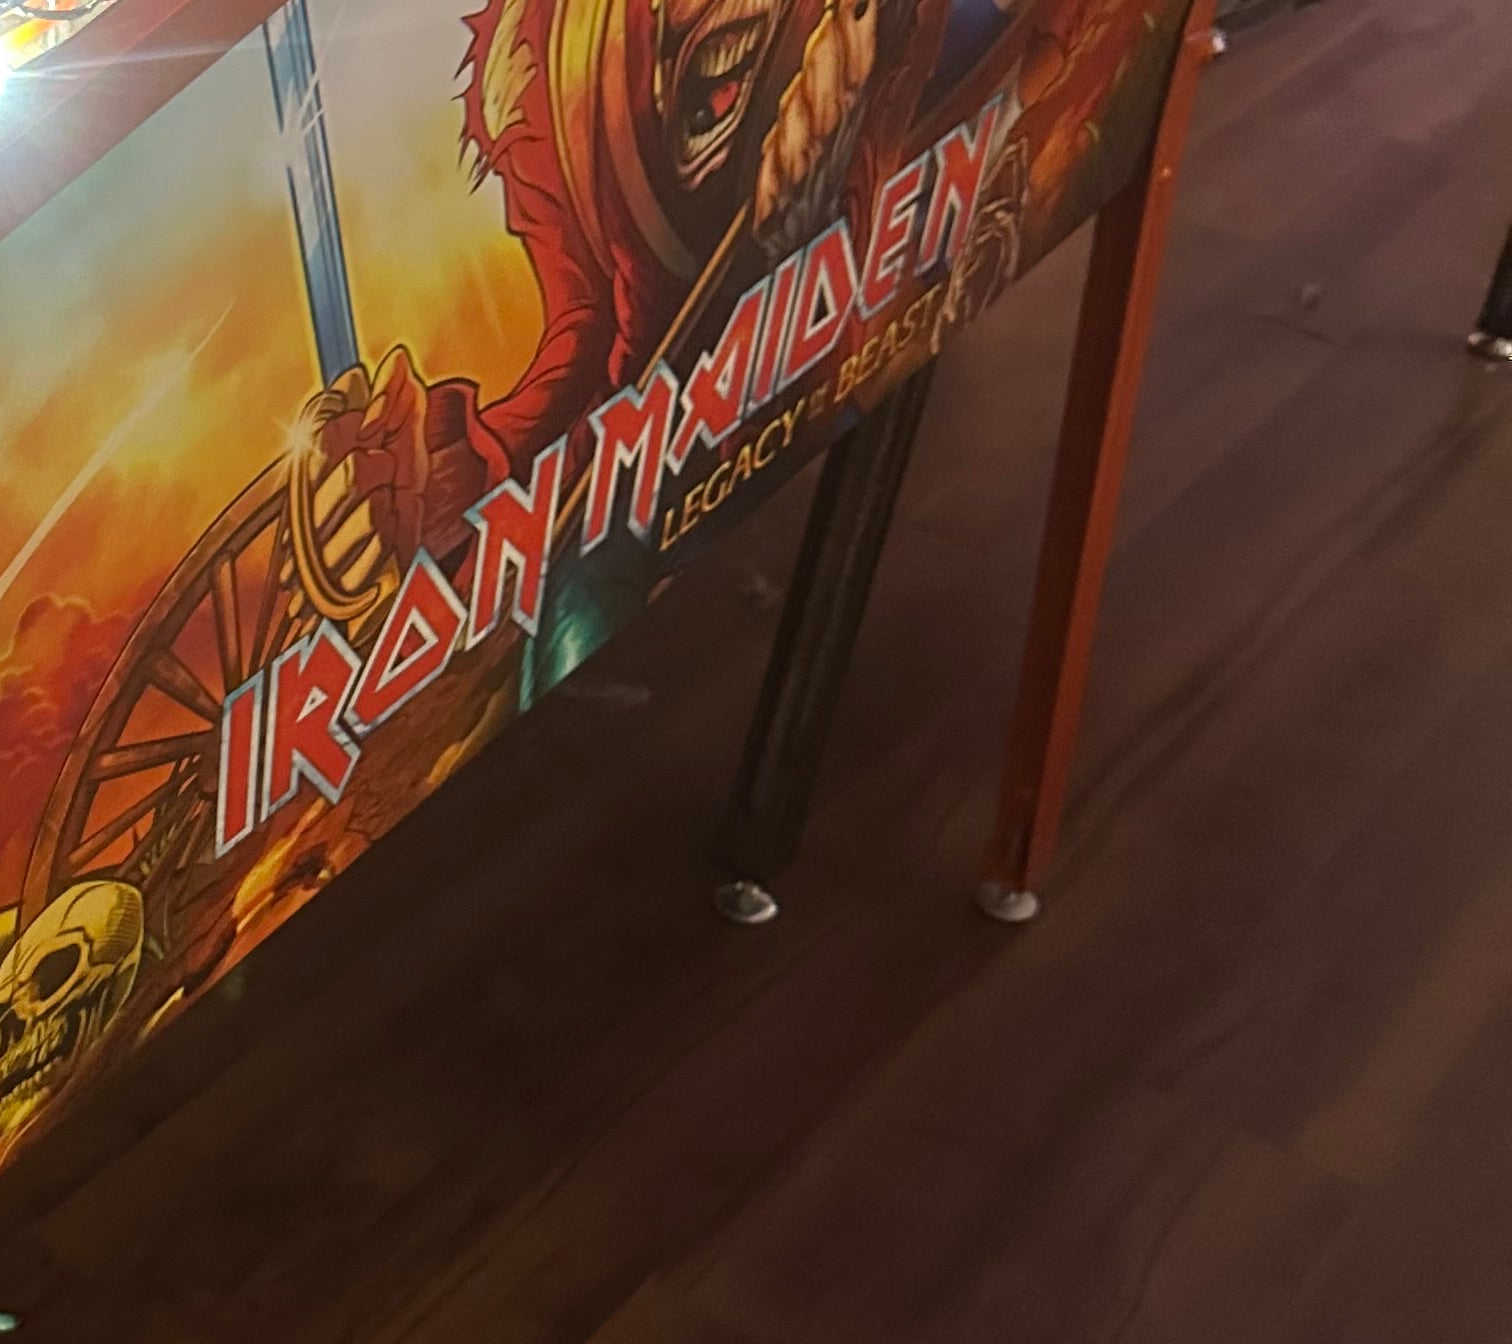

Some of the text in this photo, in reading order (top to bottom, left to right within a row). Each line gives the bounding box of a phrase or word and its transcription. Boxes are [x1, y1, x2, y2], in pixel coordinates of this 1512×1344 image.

[834, 282, 943, 404] BEAST
[216, 92, 1007, 857] IRON MAIDEN
[659, 397, 806, 552] LEGACY
